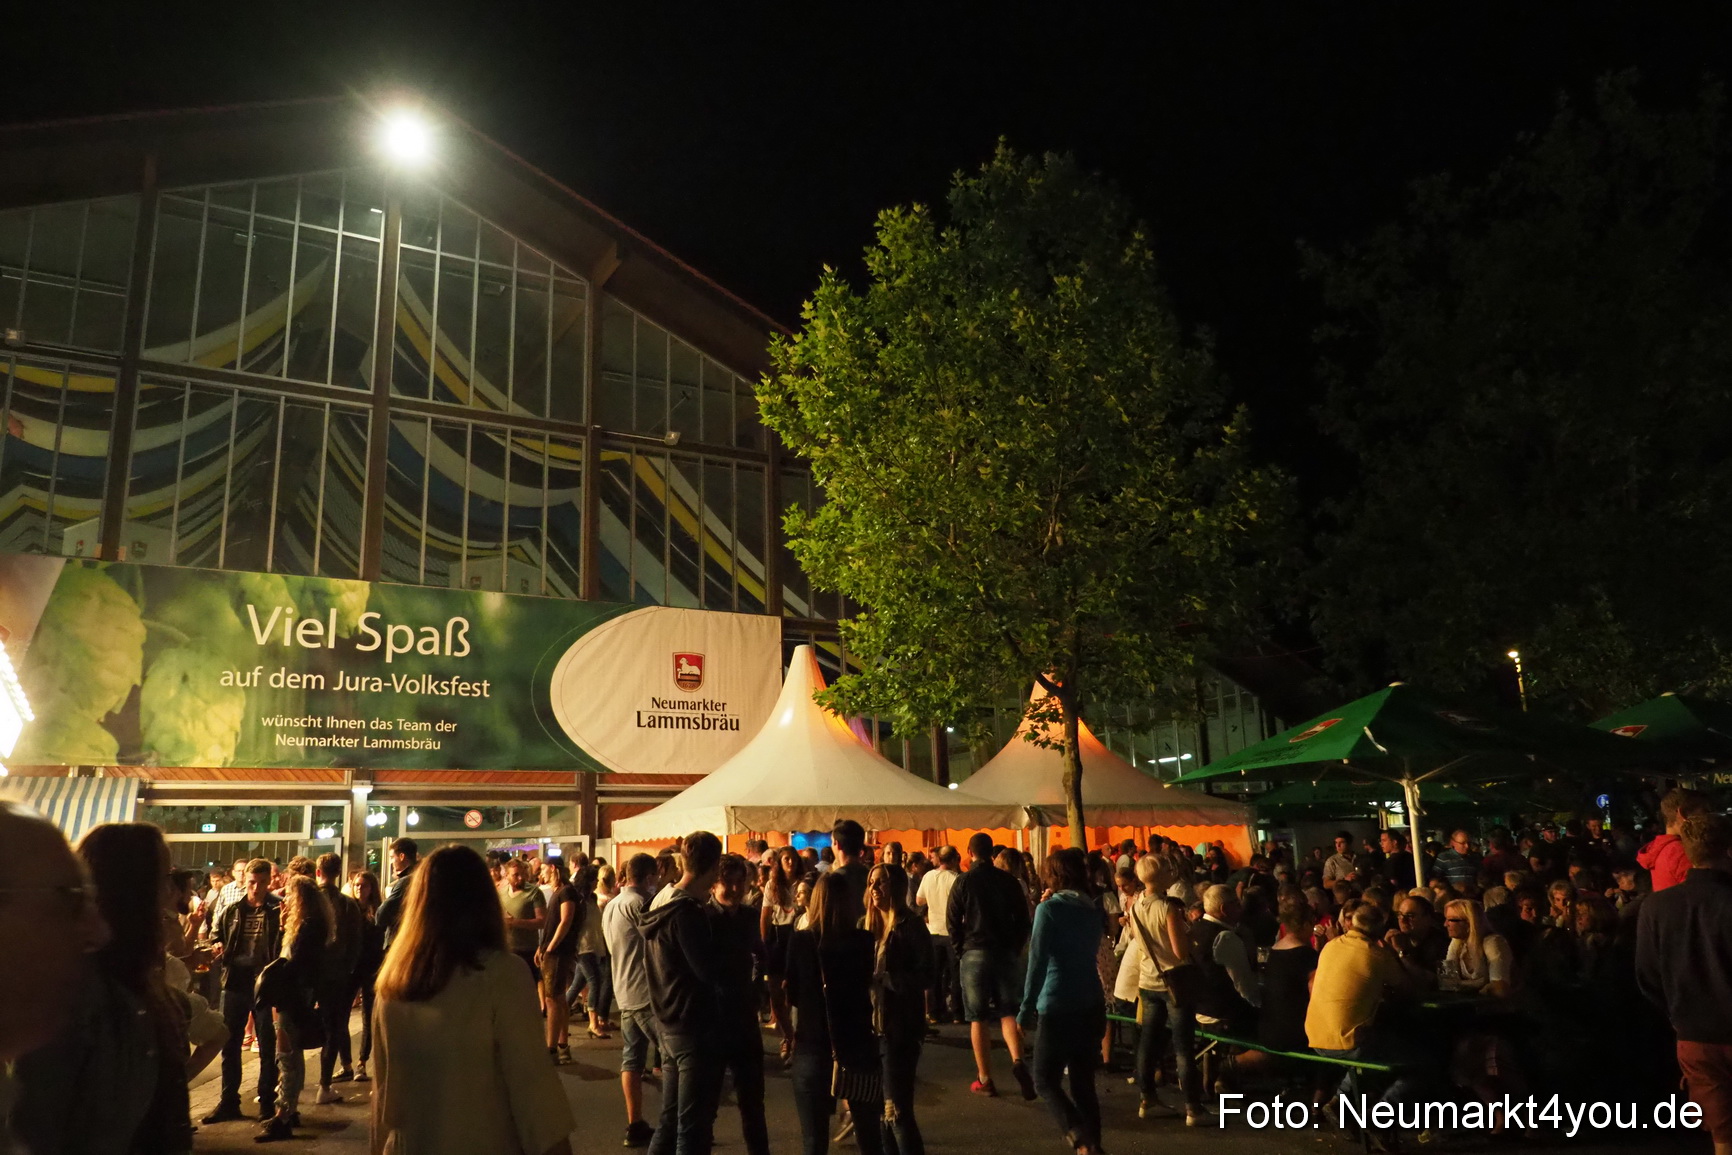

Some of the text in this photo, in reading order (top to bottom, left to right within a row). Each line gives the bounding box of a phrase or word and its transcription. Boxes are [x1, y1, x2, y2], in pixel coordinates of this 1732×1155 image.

[246, 604, 471, 663] Viel Spaß
[219, 666, 491, 698] auf dem Jura-Volksfest
[651, 697, 727, 711] Neumarkter
[261, 715, 457, 732] wünscht Ihnen das Team der
[636, 711, 740, 731] Lammsbräu
[275, 734, 441, 750] Neumarkter Lammsbräu
